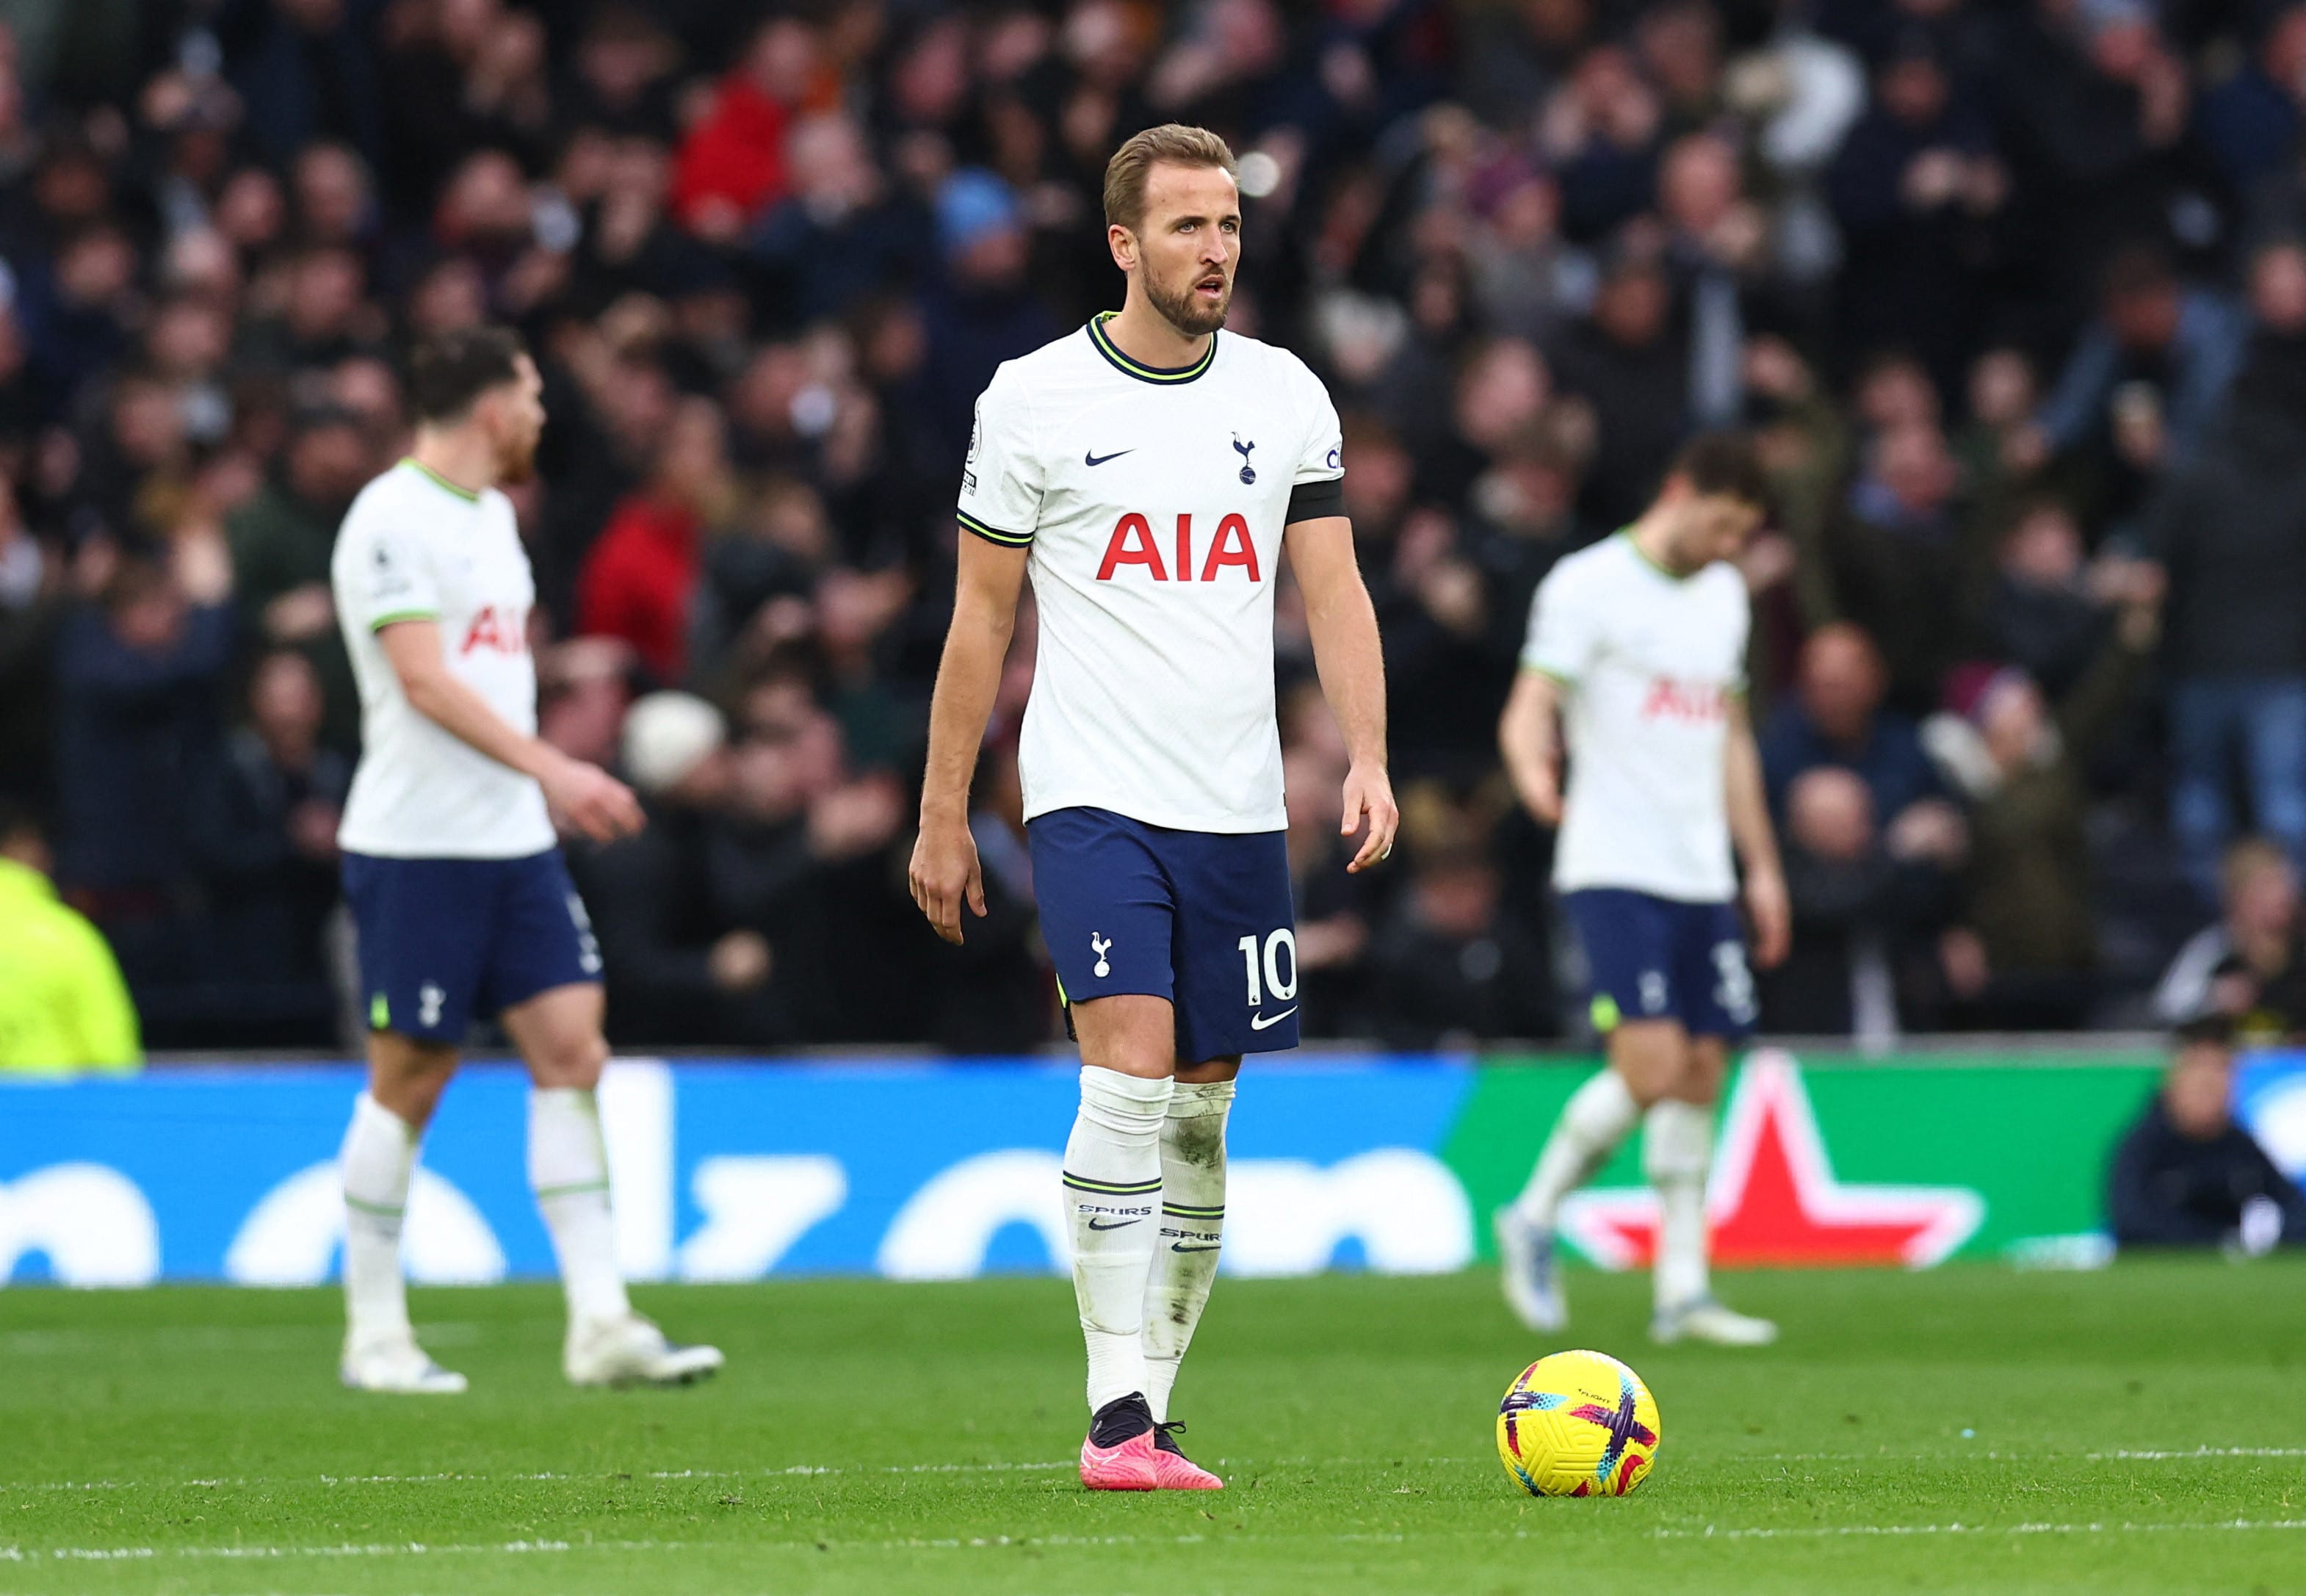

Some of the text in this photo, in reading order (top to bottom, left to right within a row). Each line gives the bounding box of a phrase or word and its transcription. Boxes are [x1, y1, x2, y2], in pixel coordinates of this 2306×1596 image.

[1096, 513, 1261, 582] AIA
[1238, 928, 1297, 1005] 10
[1079, 1204, 1152, 1216] SPURS
[1160, 1227, 1222, 1241] SPUR
